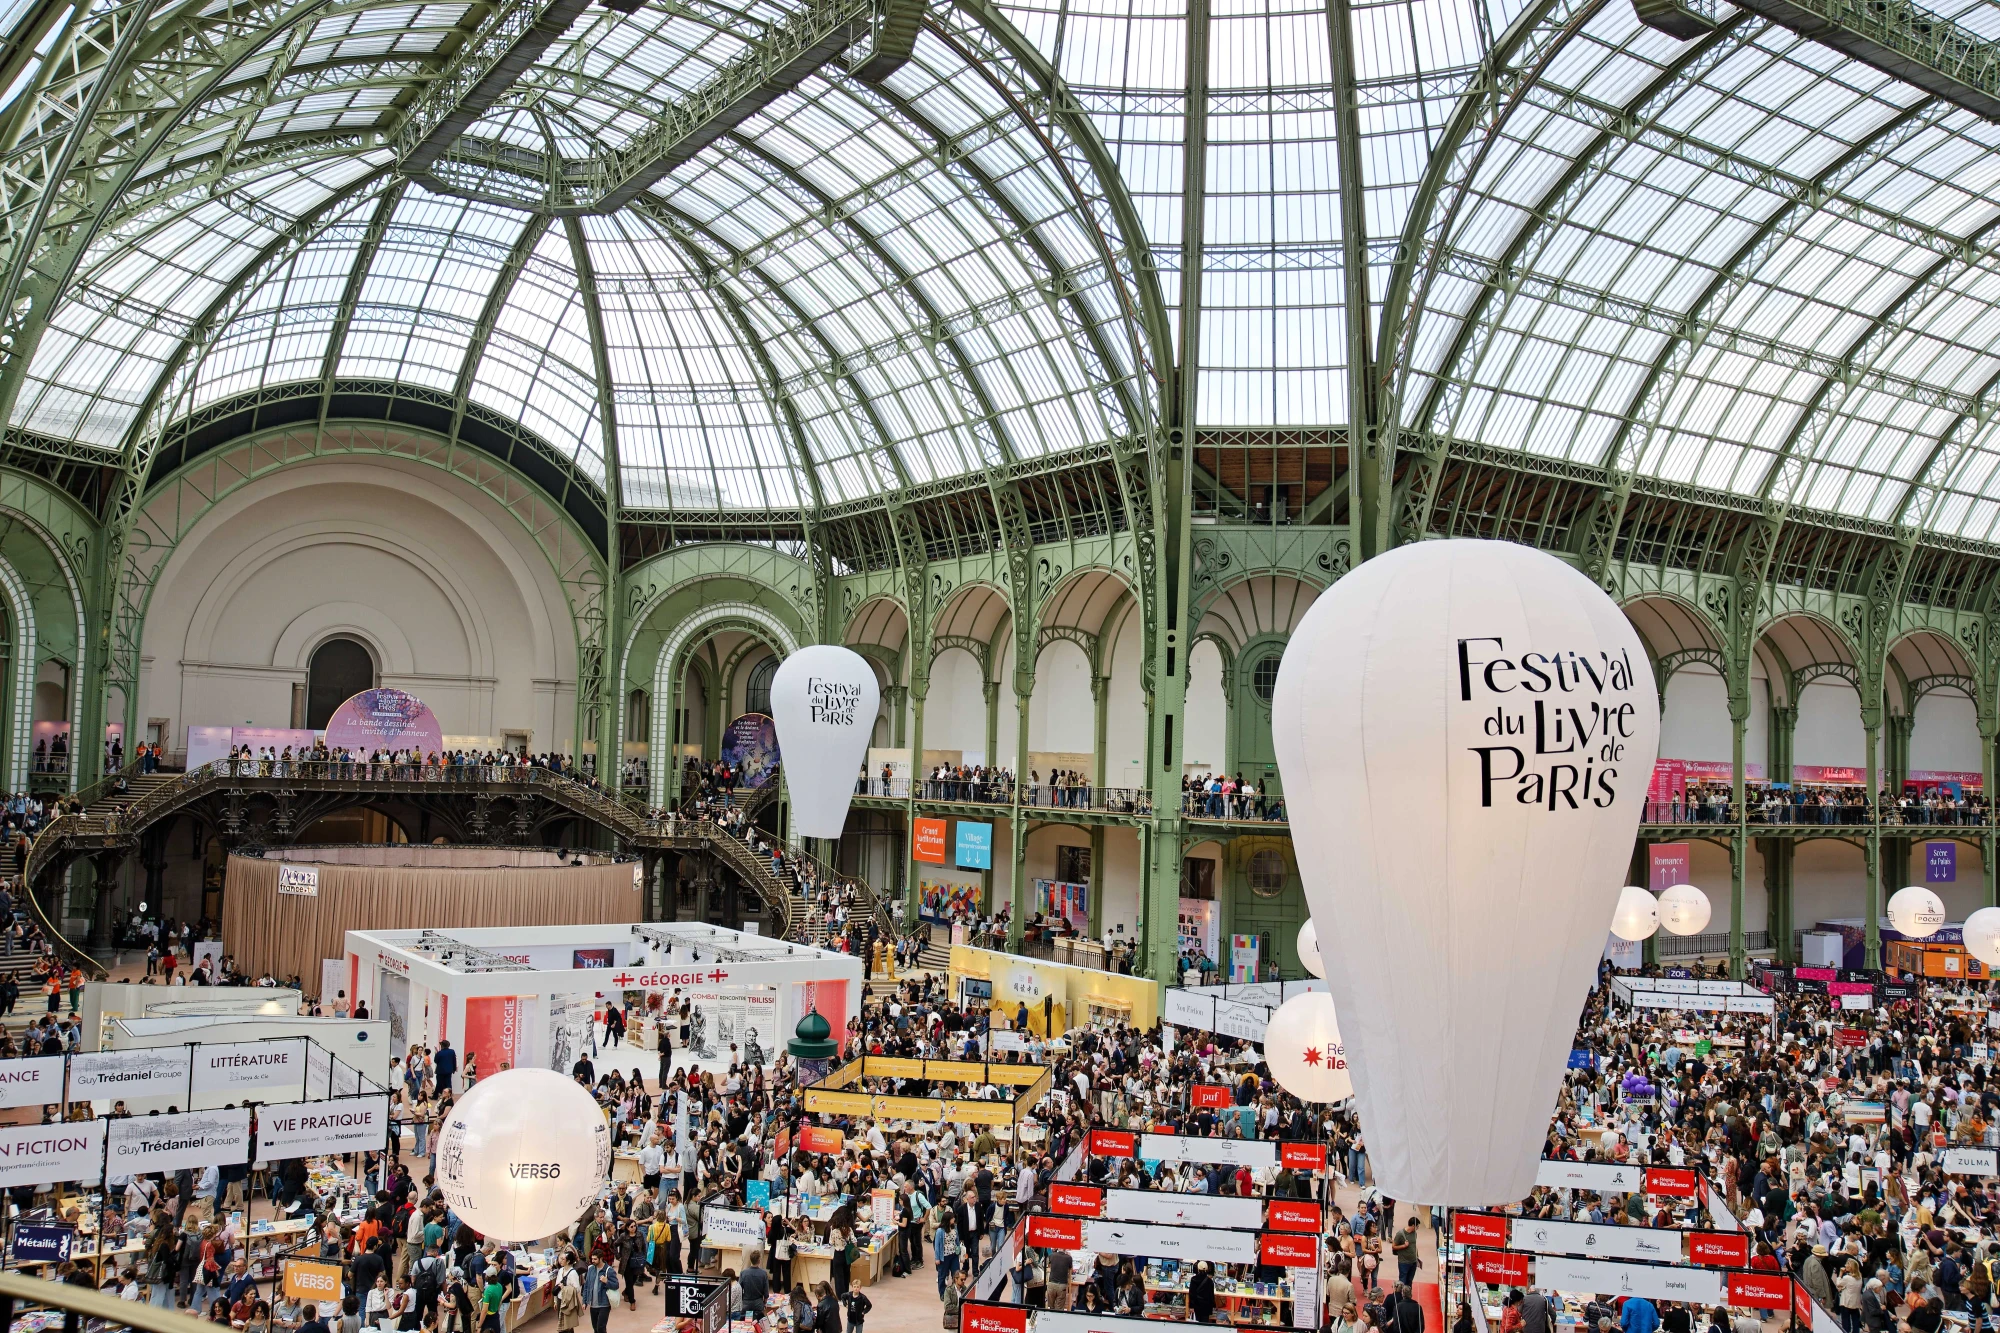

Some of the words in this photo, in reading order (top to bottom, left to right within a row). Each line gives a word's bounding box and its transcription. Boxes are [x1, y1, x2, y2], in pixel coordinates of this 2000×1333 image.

[1458, 637, 1634, 701] Festival
[807, 677, 861, 696] Festival
[812, 695, 824, 704] du
[845, 706, 856, 714] de
[347, 718, 357, 726] La
[359, 718, 382, 727] bande
[384, 719, 417, 729] dessinée,
[1484, 706, 1524, 736] du
[361, 727, 387, 736] invitée
[389, 728, 429, 737] d'honneur
[1600, 736, 1625, 762] de
[922, 826, 938, 836] Grand
[917, 834, 944, 845] Auditorium
[965, 833, 984, 844] Village
[1933, 849, 1948, 857] Scène
[1654, 857, 1684, 866] Romance
[1937, 858, 1951, 866] Palais
[384, 953, 402, 972] GÉORGIE
[584, 958, 605, 968] 1921
[639, 970, 704, 987] GÉORGIE
[692, 993, 718, 1001] COMBAT
[748, 996, 774, 1004] TBILISSI
[503, 1000, 514, 1050] GÉORGIE
[211, 1053, 289, 1068] LITTÉRATURE
[78, 1075, 97, 1086] Guy
[97, 1071, 152, 1083] Trédaniel
[154, 1070, 183, 1080] Groupe
[1202, 1091, 1219, 1102] puf
[273, 1118, 296, 1132] VIE
[301, 1112, 372, 1130] PRATIQUE
[335, 1132, 364, 1140] Trédaniel
[16, 1137, 87, 1156] FICTION
[118, 1144, 140, 1156] Guy
[140, 1137, 204, 1153] Trédaniel
[206, 1136, 240, 1147] Groupe
[1102, 1138, 1119, 1146] Région
[0, 1160, 61, 1172] pportunéditions
[1958, 1158, 1990, 1167] ZULMA
[1660, 1176, 1676, 1184] Région
[1065, 1194, 1082, 1202] Région
[1283, 1211, 1300, 1219] Région
[710, 1216, 735, 1227] L'arbre
[735, 1220, 747, 1229] qui
[730, 1227, 758, 1235] marche
[1043, 1227, 1061, 1235] Région
[17, 1236, 57, 1249] Métailié
[1705, 1243, 1724, 1251] Région
[1276, 1245, 1295, 1253] Région
[1485, 1261, 1505, 1270] Région
[1745, 1284, 1766, 1293] Région
[686, 1300, 704, 1315] Caillo
[980, 1317, 1002, 1326] Région
